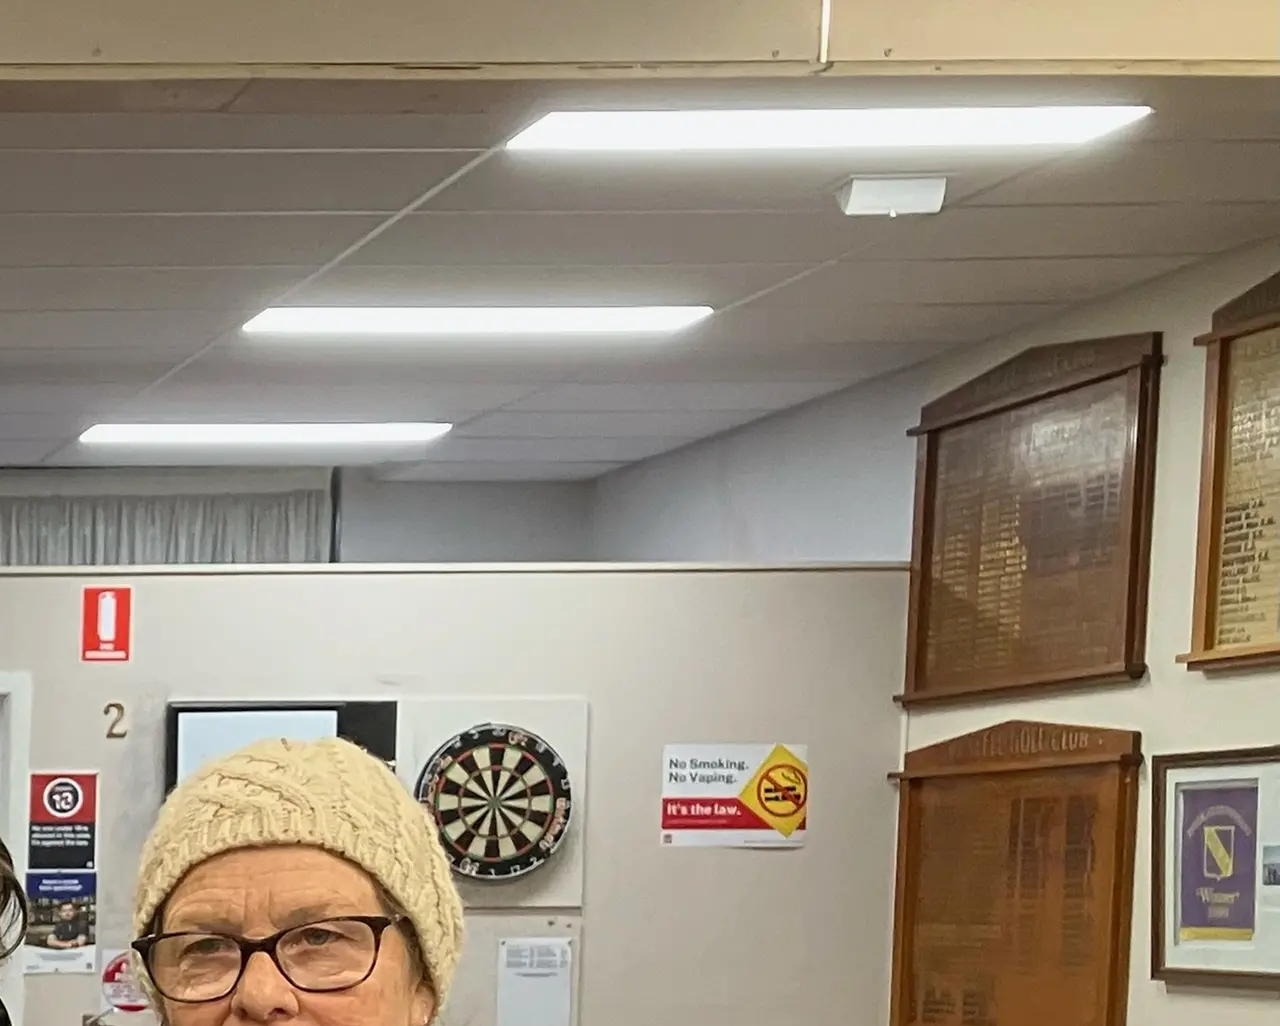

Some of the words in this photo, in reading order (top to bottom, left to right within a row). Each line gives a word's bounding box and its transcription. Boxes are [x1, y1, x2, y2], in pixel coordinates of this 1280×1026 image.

[103, 703, 128, 739] 2
[1051, 730, 1089, 752] CLUB
[668, 758, 687, 770] No
[689, 758, 749, 771] Smoking.
[668, 772, 687, 783] No
[689, 772, 738, 785] Vaping.
[666, 803, 688, 816] It's
[690, 803, 712, 816] the
[714, 803, 742, 816] law.
